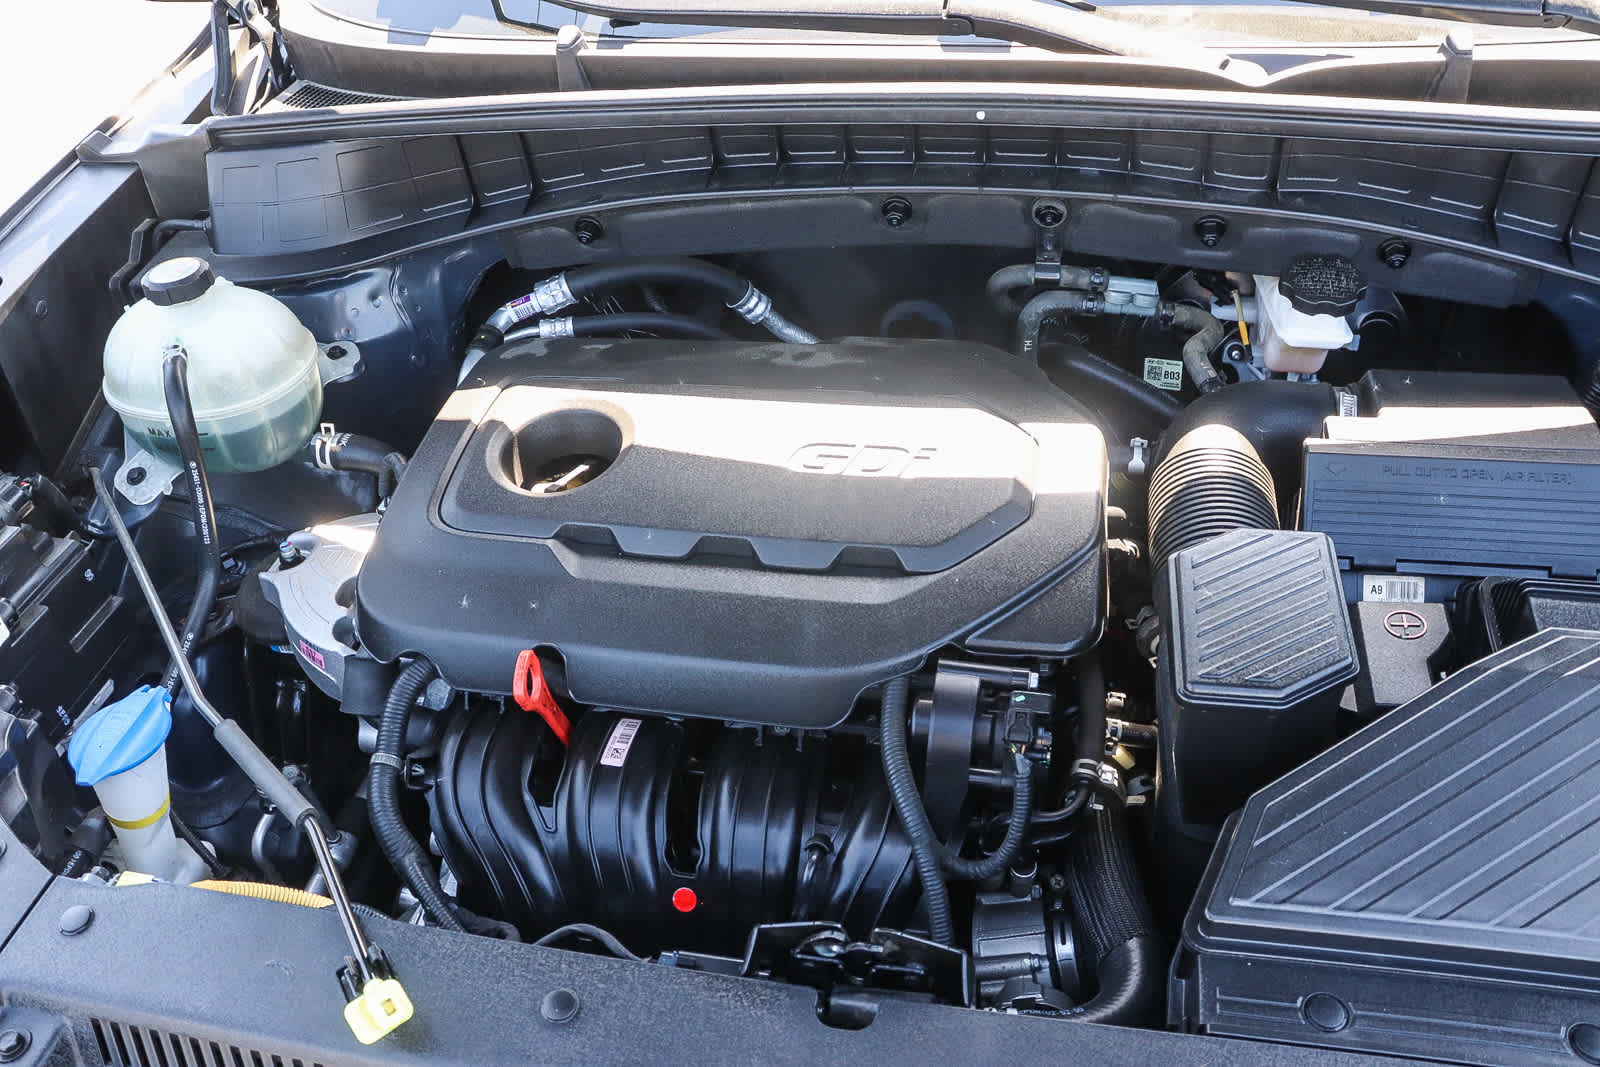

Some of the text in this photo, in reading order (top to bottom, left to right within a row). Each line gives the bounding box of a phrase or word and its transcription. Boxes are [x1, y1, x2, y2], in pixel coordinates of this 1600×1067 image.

[1163, 370, 1181, 381] B03
[147, 426, 172, 438] MAX
[1383, 464, 1576, 486] PULL OUT TO OPEN (AIR FILTER)
[1370, 584, 1383, 595] A9
